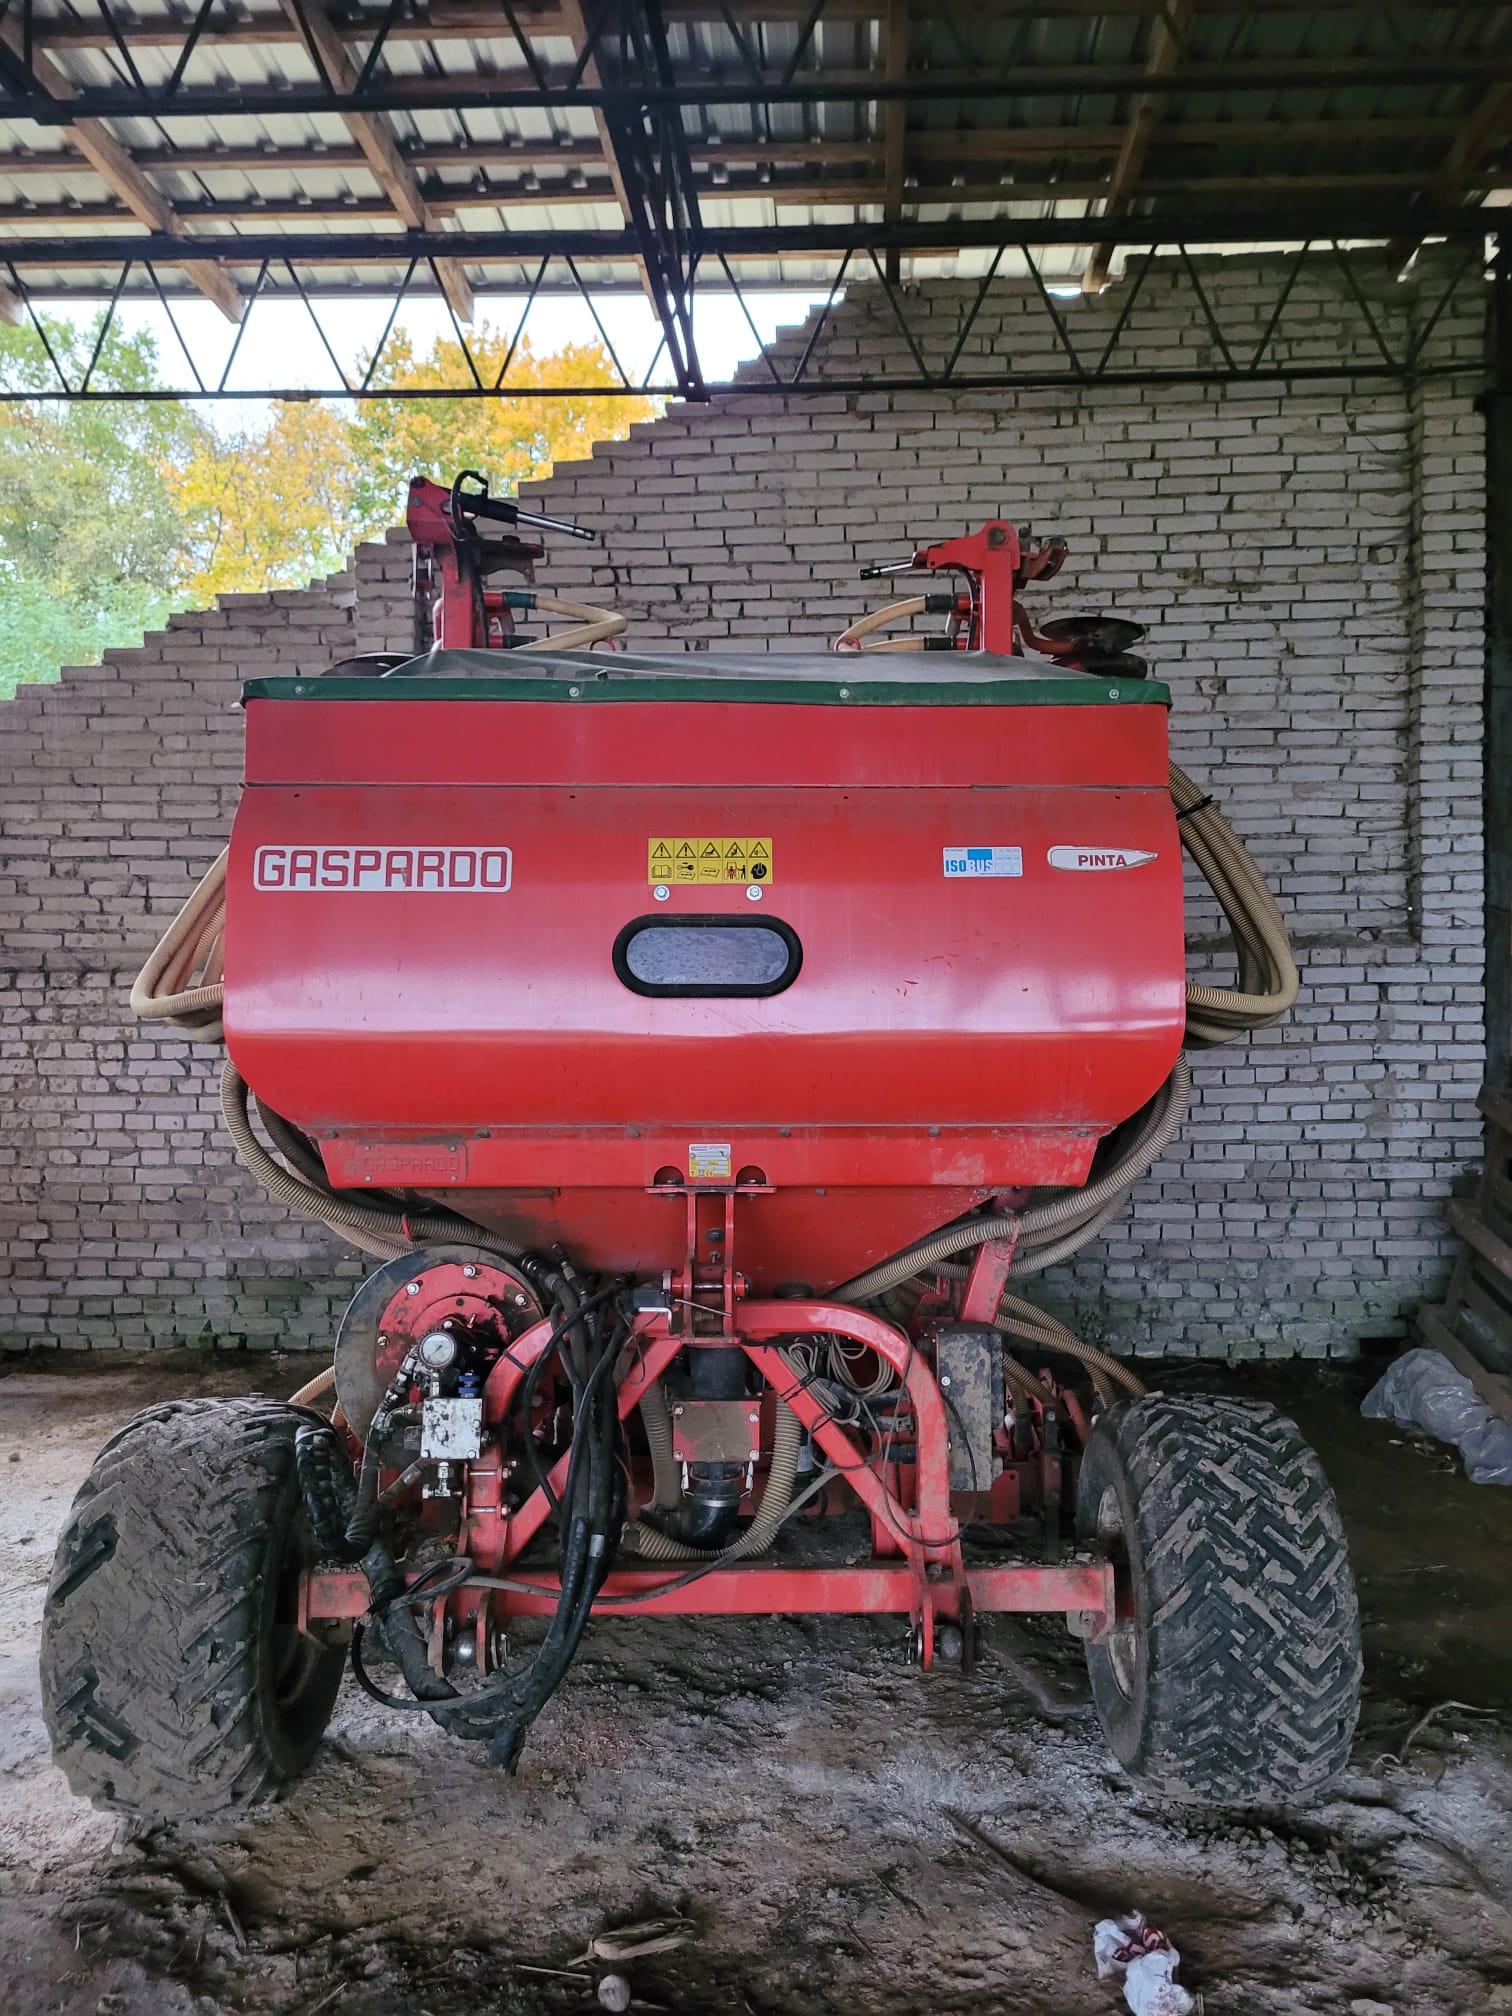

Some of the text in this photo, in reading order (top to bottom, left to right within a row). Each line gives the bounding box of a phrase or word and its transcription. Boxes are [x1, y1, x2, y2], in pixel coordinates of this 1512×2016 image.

[1078, 854, 1127, 867] PINTA
[258, 850, 507, 888] GASPARDO
[362, 1156, 460, 1172] GASPARDO
